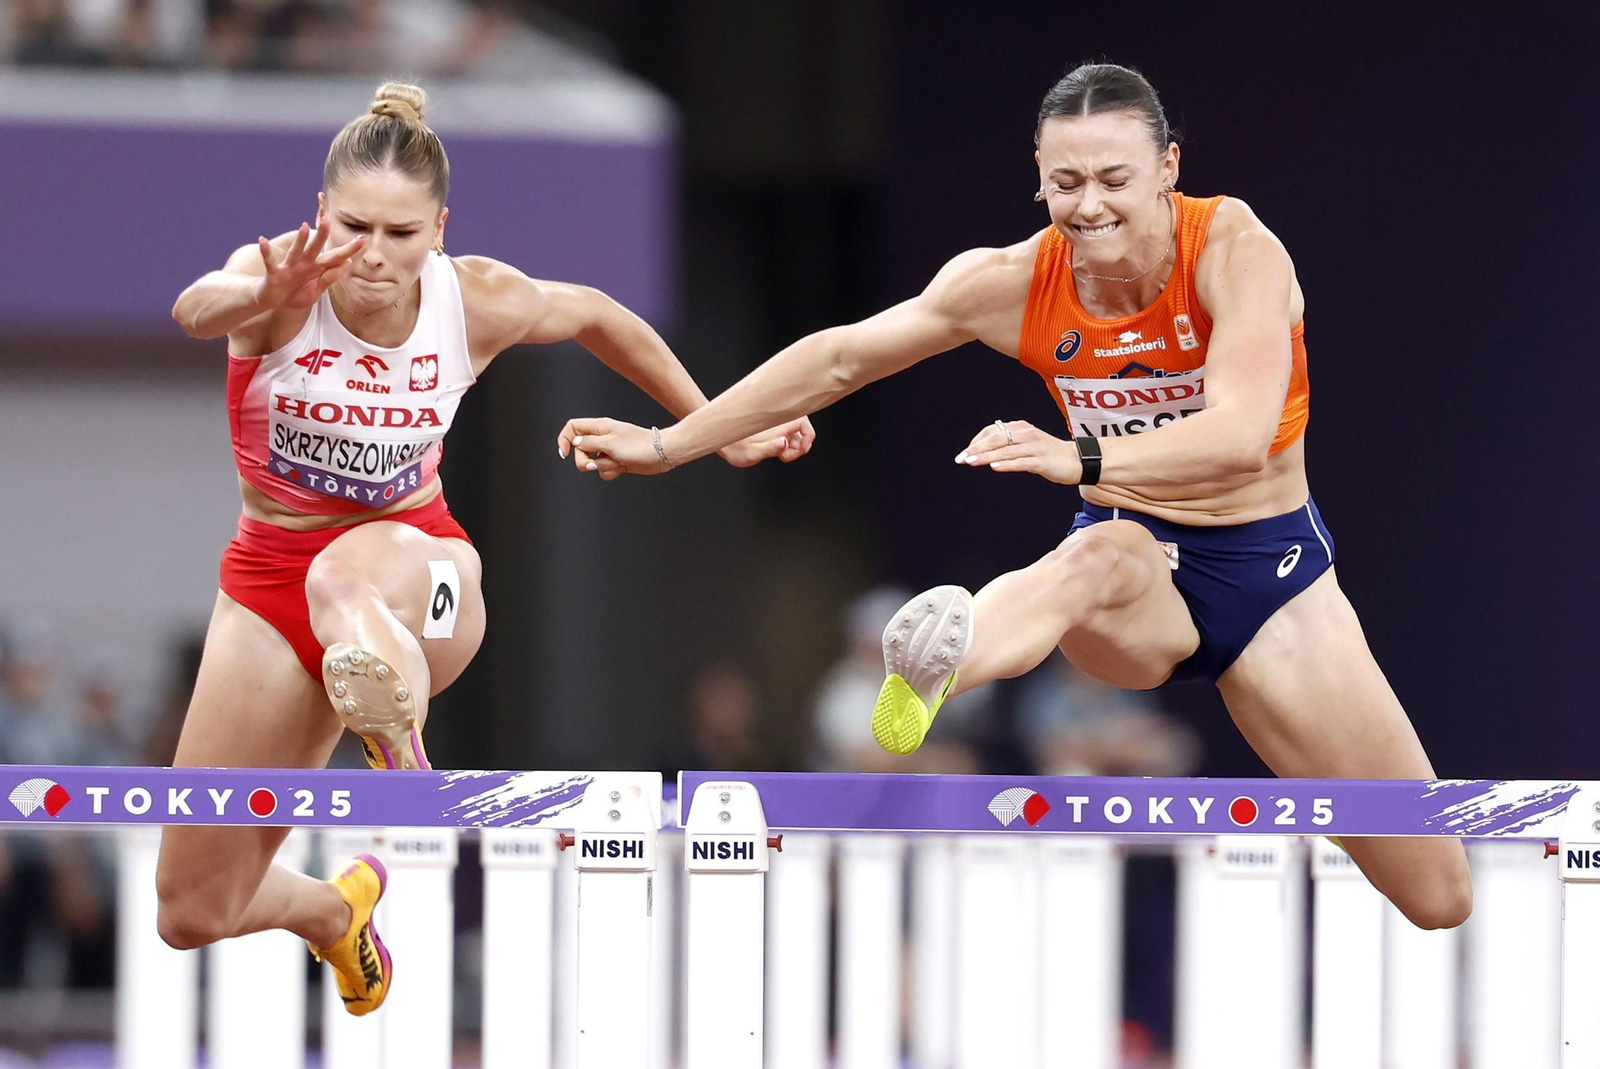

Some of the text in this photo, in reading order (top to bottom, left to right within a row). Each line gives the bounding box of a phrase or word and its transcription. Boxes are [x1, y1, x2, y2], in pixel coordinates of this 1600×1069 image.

[1094, 337, 1166, 357] Staatsloterij
[294, 349, 343, 375] 4F
[346, 379, 391, 394] ORLEN
[1063, 378, 1205, 410] HOND
[274, 394, 443, 428] HONDA
[397, 470, 417, 493] 25
[432, 582, 454, 621] 6
[292, 788, 352, 818] 25
[1274, 797, 1334, 827] 25
[581, 839, 644, 859] NISHI
[692, 841, 754, 860] NISHI
